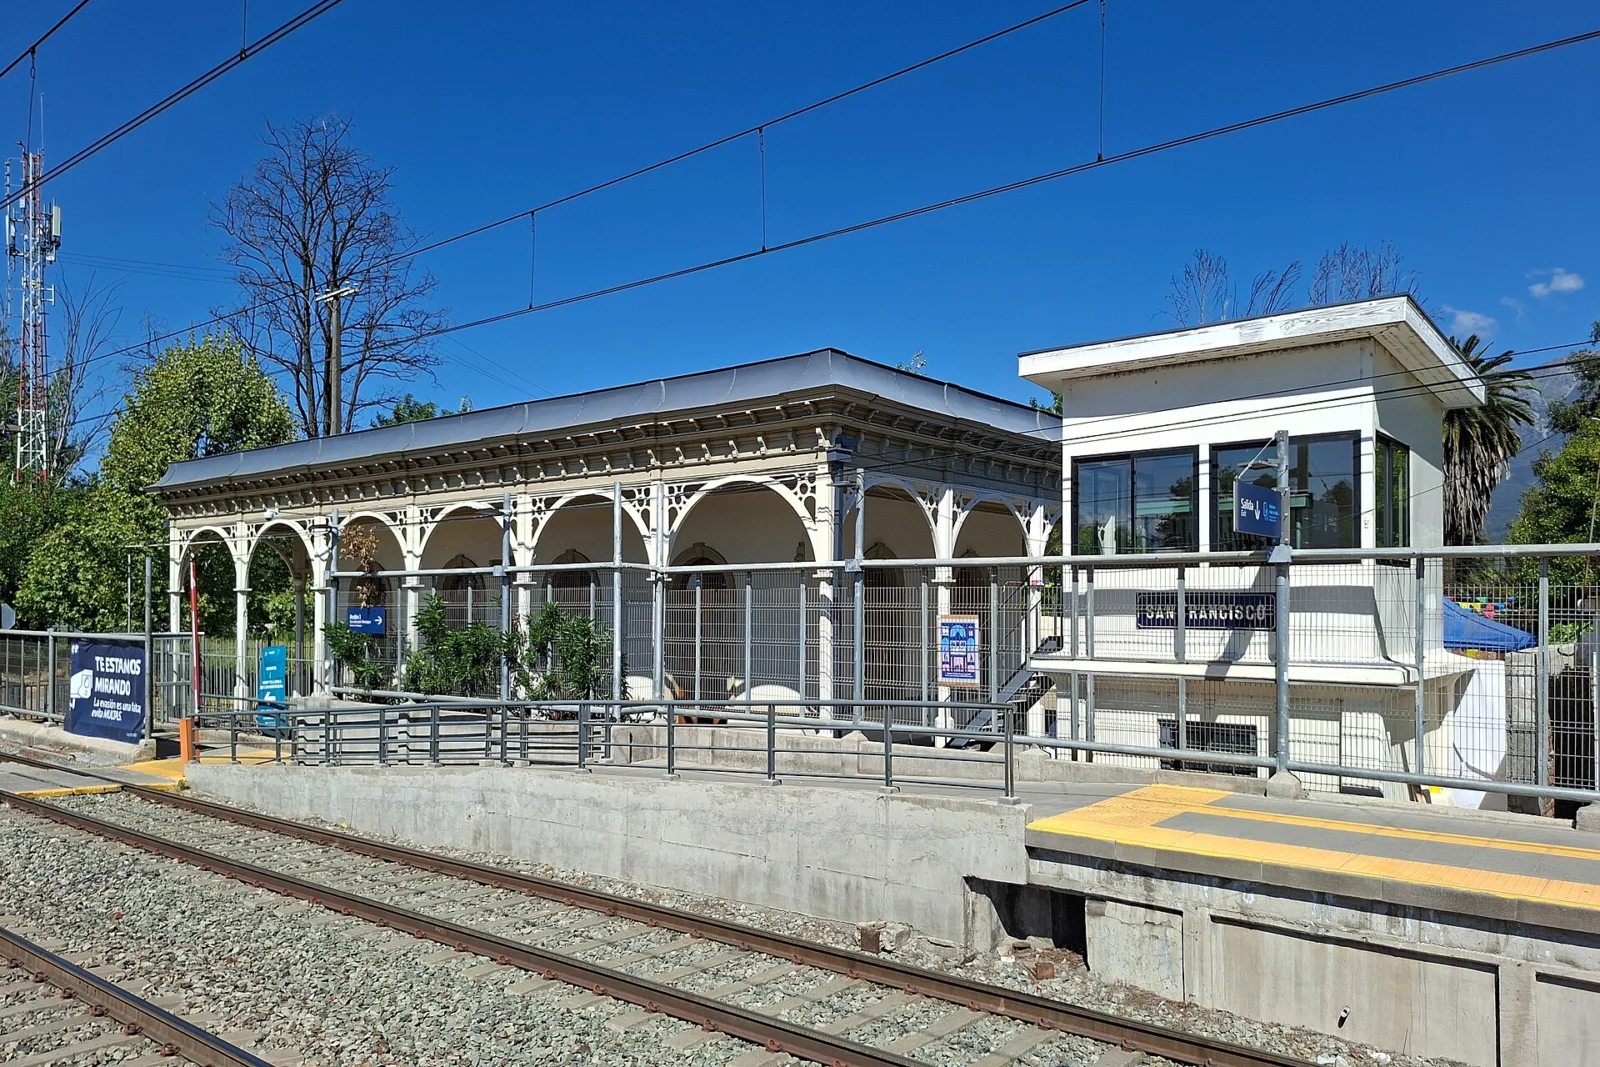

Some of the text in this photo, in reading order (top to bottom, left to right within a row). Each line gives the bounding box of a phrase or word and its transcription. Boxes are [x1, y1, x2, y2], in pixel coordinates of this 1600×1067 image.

[1240, 497, 1254, 511] Salida
[1146, 604, 1266, 621] SAN RANCISCO
[95, 656, 105, 672] TE
[94, 677, 131, 696] MIRANDO
[93, 697, 100, 707] La
